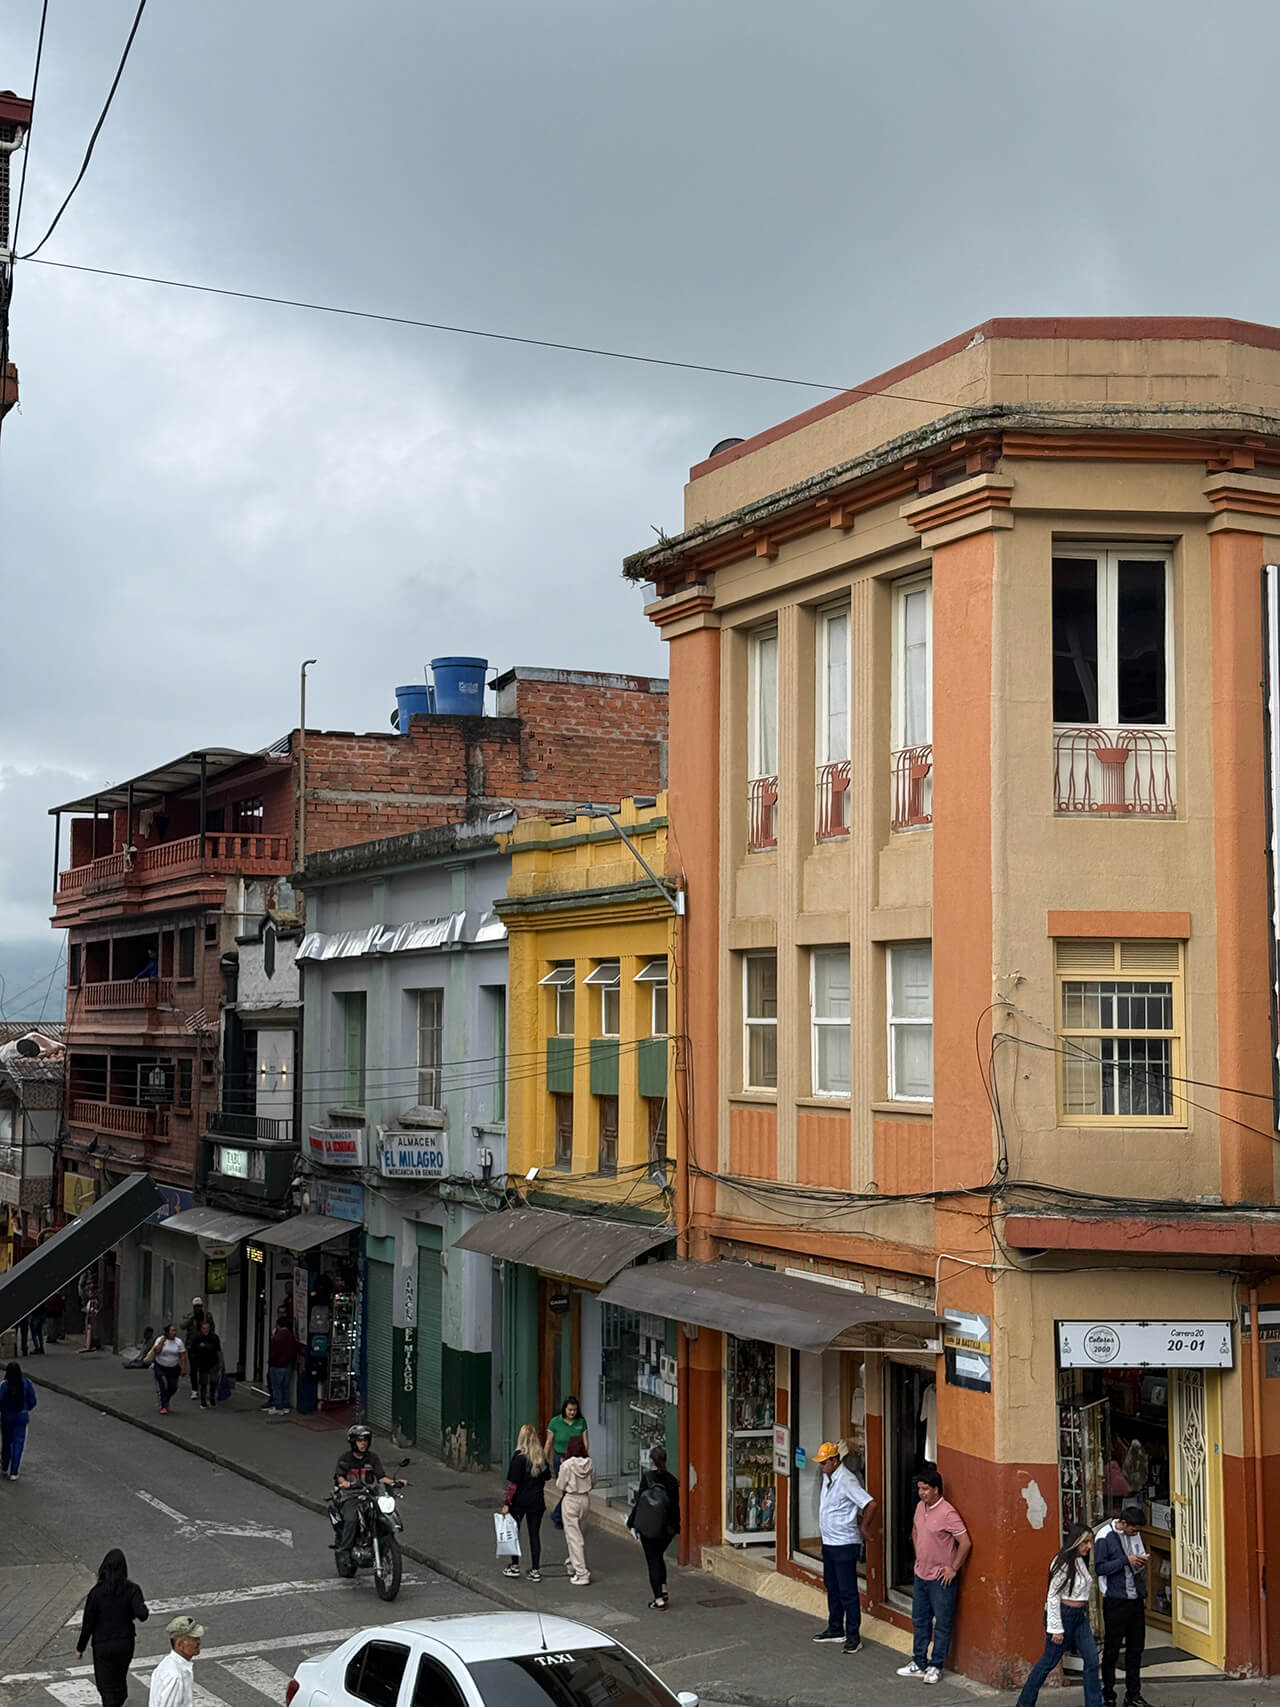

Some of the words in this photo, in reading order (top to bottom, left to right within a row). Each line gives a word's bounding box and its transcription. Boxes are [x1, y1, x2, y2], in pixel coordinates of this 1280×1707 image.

[398, 1136, 436, 1147] ALMACEN
[384, 1150, 396, 1167] EL
[399, 1150, 444, 1168] MILAGRO
[422, 1168, 443, 1177] GENERAL
[1167, 1339, 1206, 1351] 20-01
[403, 1344, 414, 1392] MILAGRO
[534, 1653, 576, 1666] TAXI
